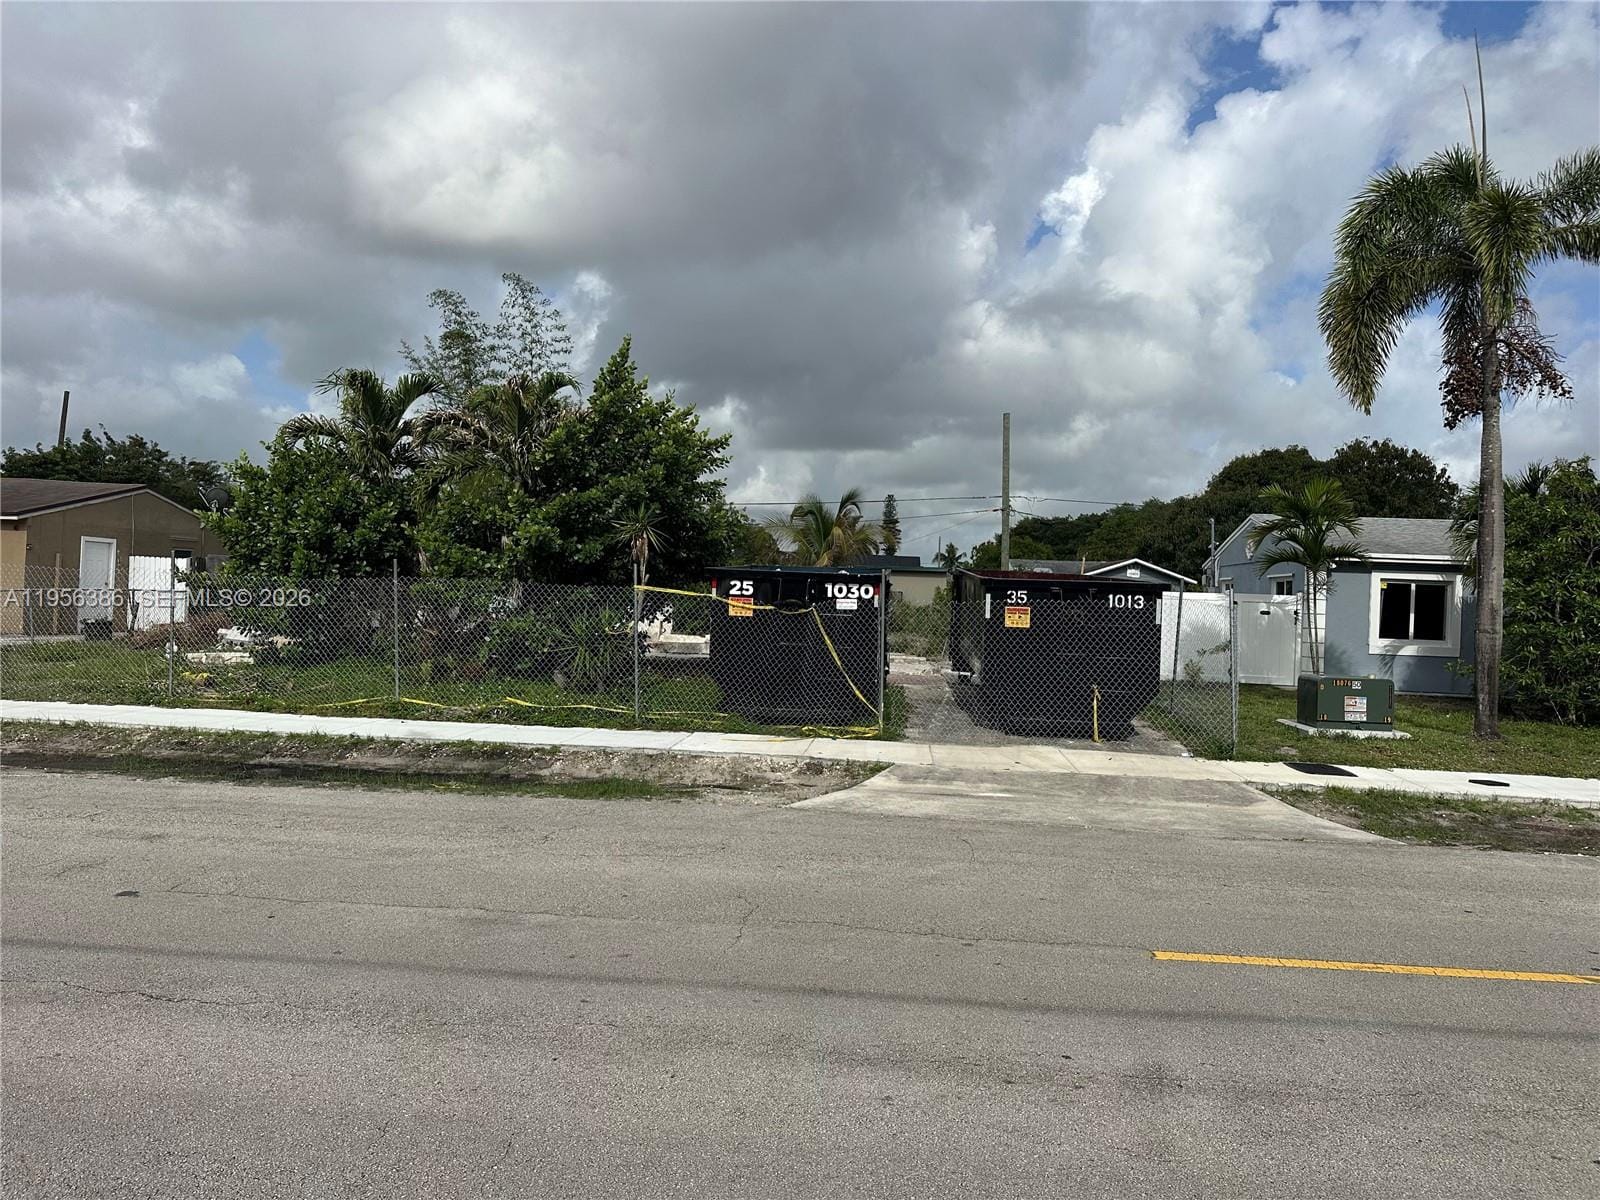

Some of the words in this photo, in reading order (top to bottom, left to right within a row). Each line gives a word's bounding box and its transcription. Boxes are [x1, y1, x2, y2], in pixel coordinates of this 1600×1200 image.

[729, 580, 754, 595] 25
[825, 583, 874, 599] 1030
[1006, 590, 1028, 604] 35
[1108, 594, 1145, 609] 1013
